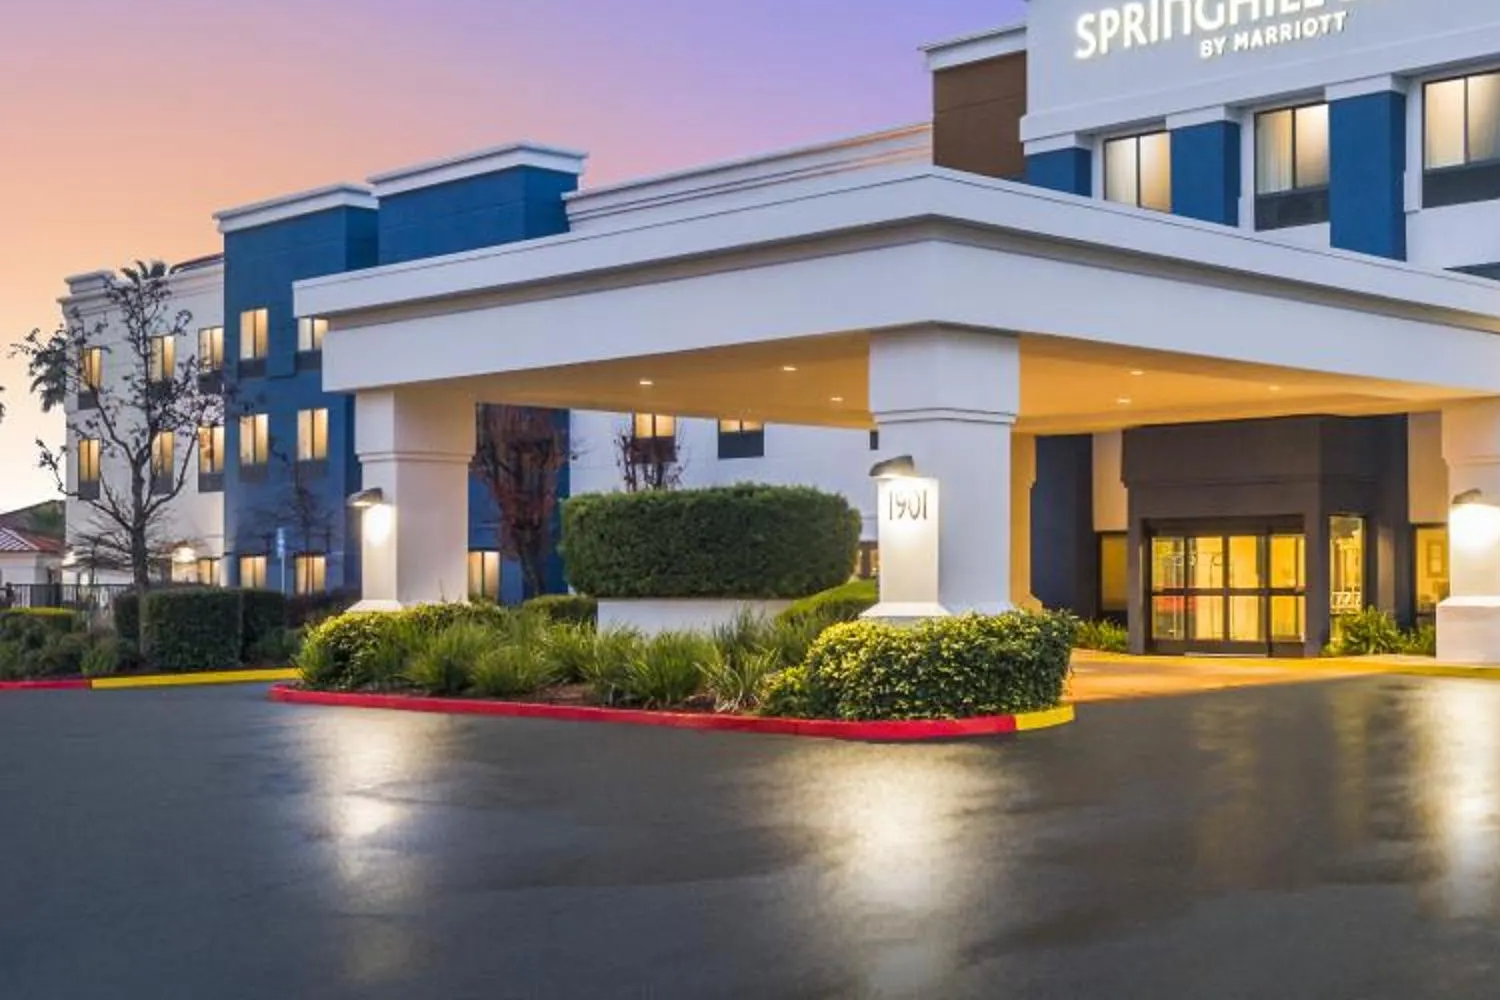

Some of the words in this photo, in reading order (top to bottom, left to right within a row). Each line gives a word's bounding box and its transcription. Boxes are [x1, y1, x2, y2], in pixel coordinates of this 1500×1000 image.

[1201, 37, 1226, 59] BY
[1233, 11, 1348, 52] MARRIOTT
[889, 488, 928, 521] 1901
